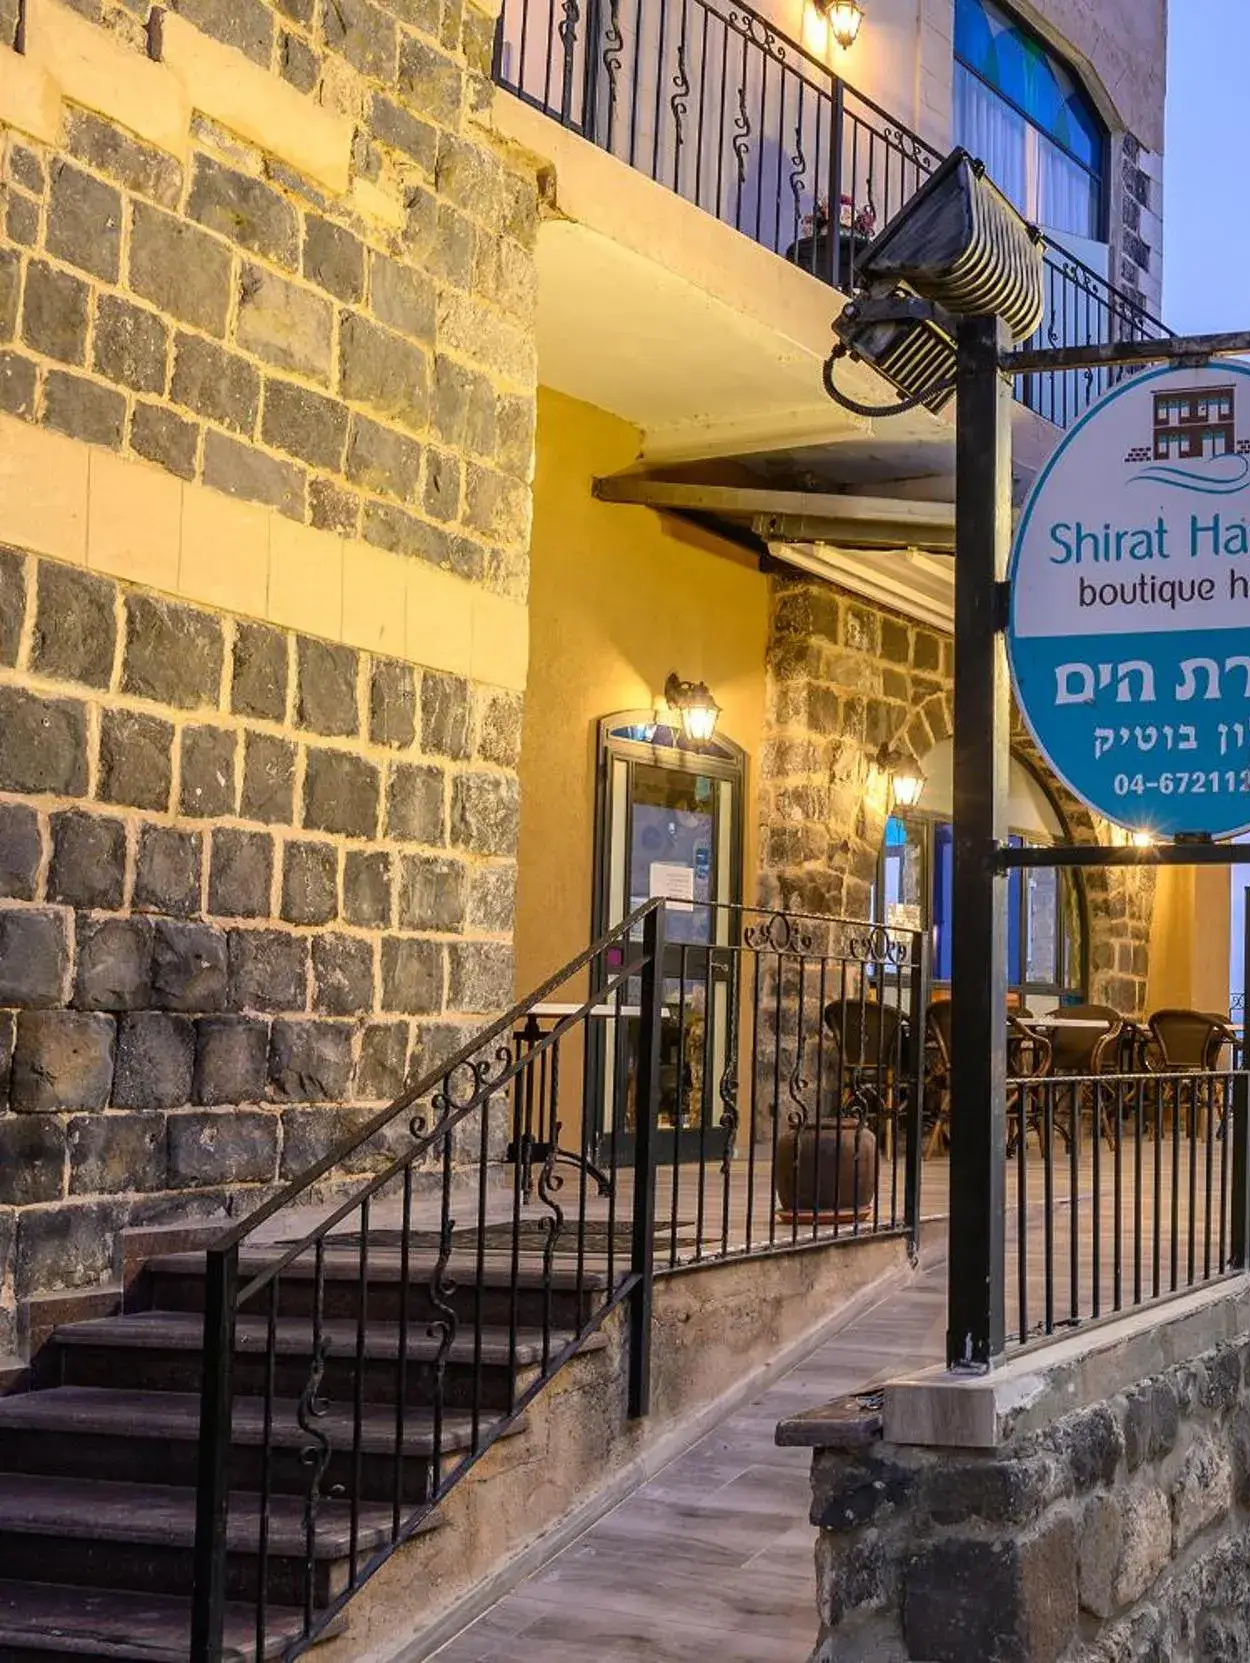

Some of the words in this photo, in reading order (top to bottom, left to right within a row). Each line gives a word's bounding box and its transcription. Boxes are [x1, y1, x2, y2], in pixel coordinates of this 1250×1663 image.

[1049, 516, 1170, 564] Shirat
[1079, 573, 1215, 610] boutique
[1054, 659, 1157, 706] הים
[1093, 726, 1199, 759] בוטיק
